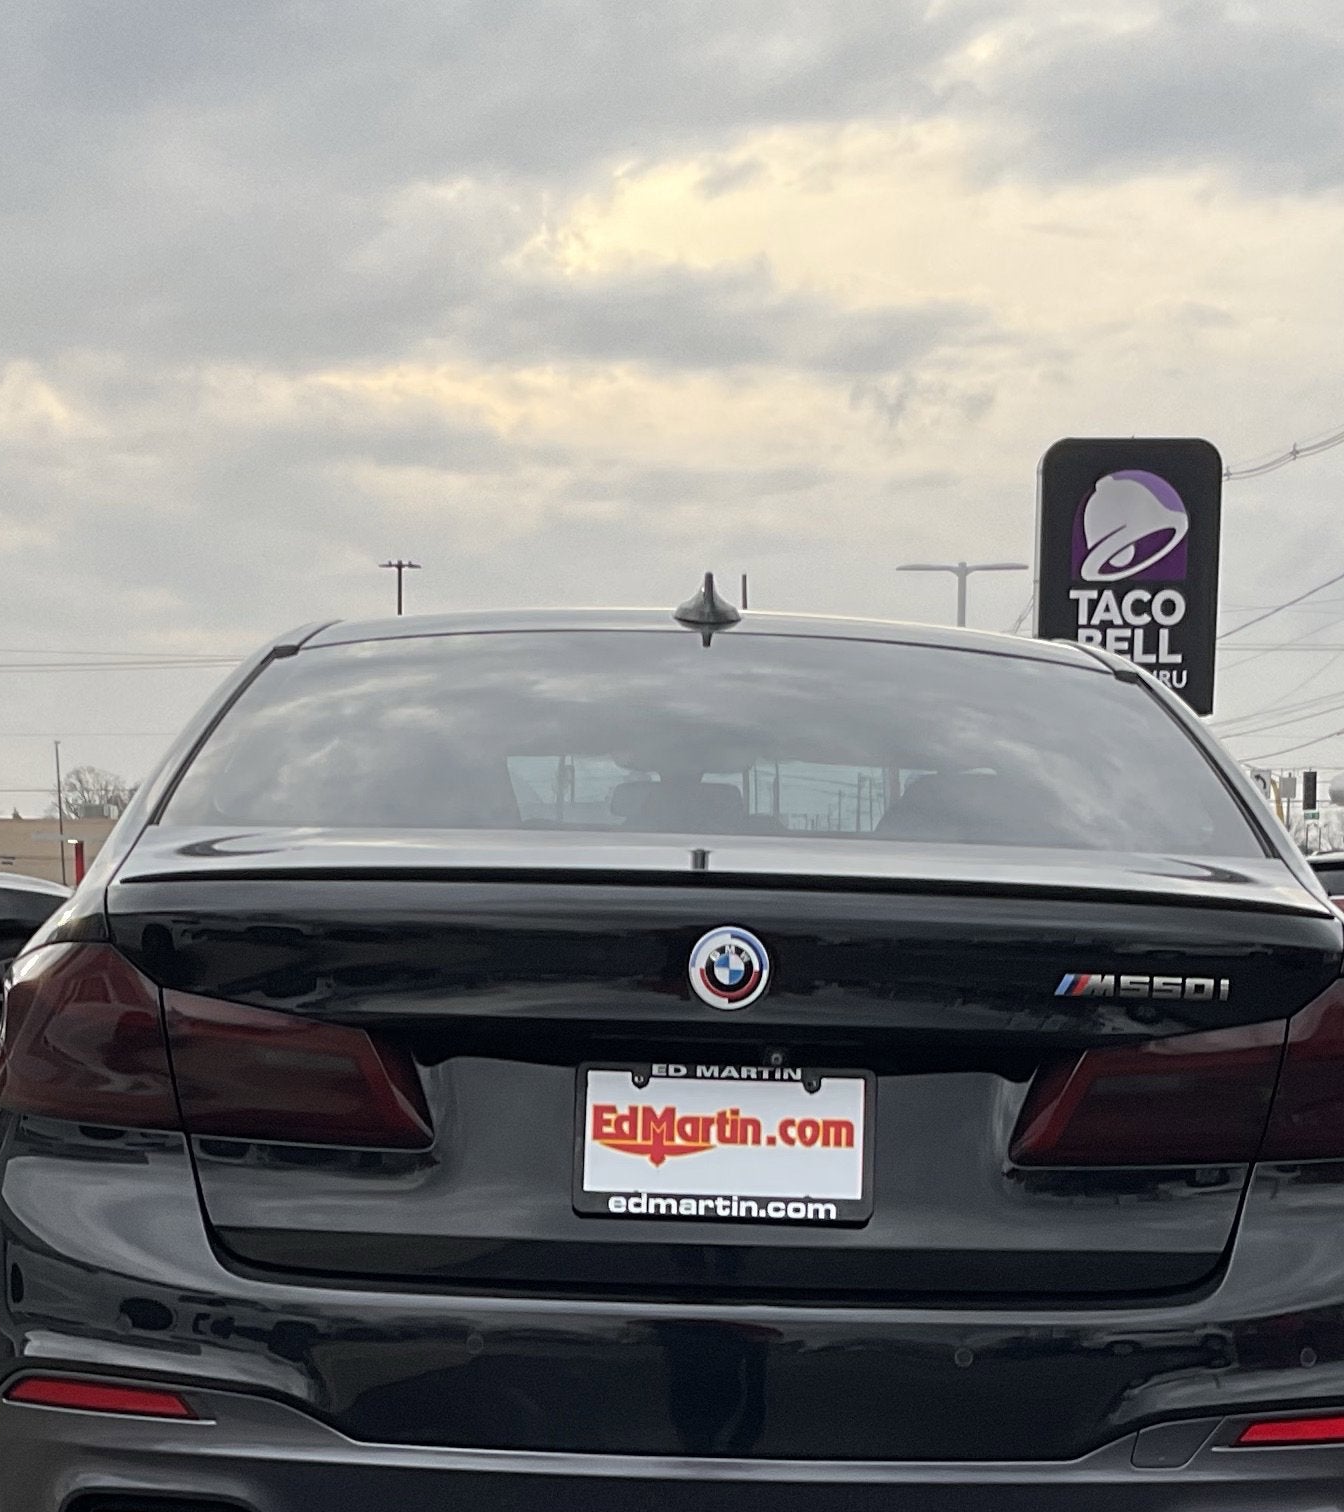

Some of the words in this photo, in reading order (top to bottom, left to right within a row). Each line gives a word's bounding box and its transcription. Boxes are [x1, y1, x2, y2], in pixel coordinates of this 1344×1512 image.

[1069, 588, 1186, 627] TACO
[652, 1063, 688, 1078] ED
[695, 1064, 802, 1080] MARTIN
[608, 1193, 838, 1220] edmartin.com
